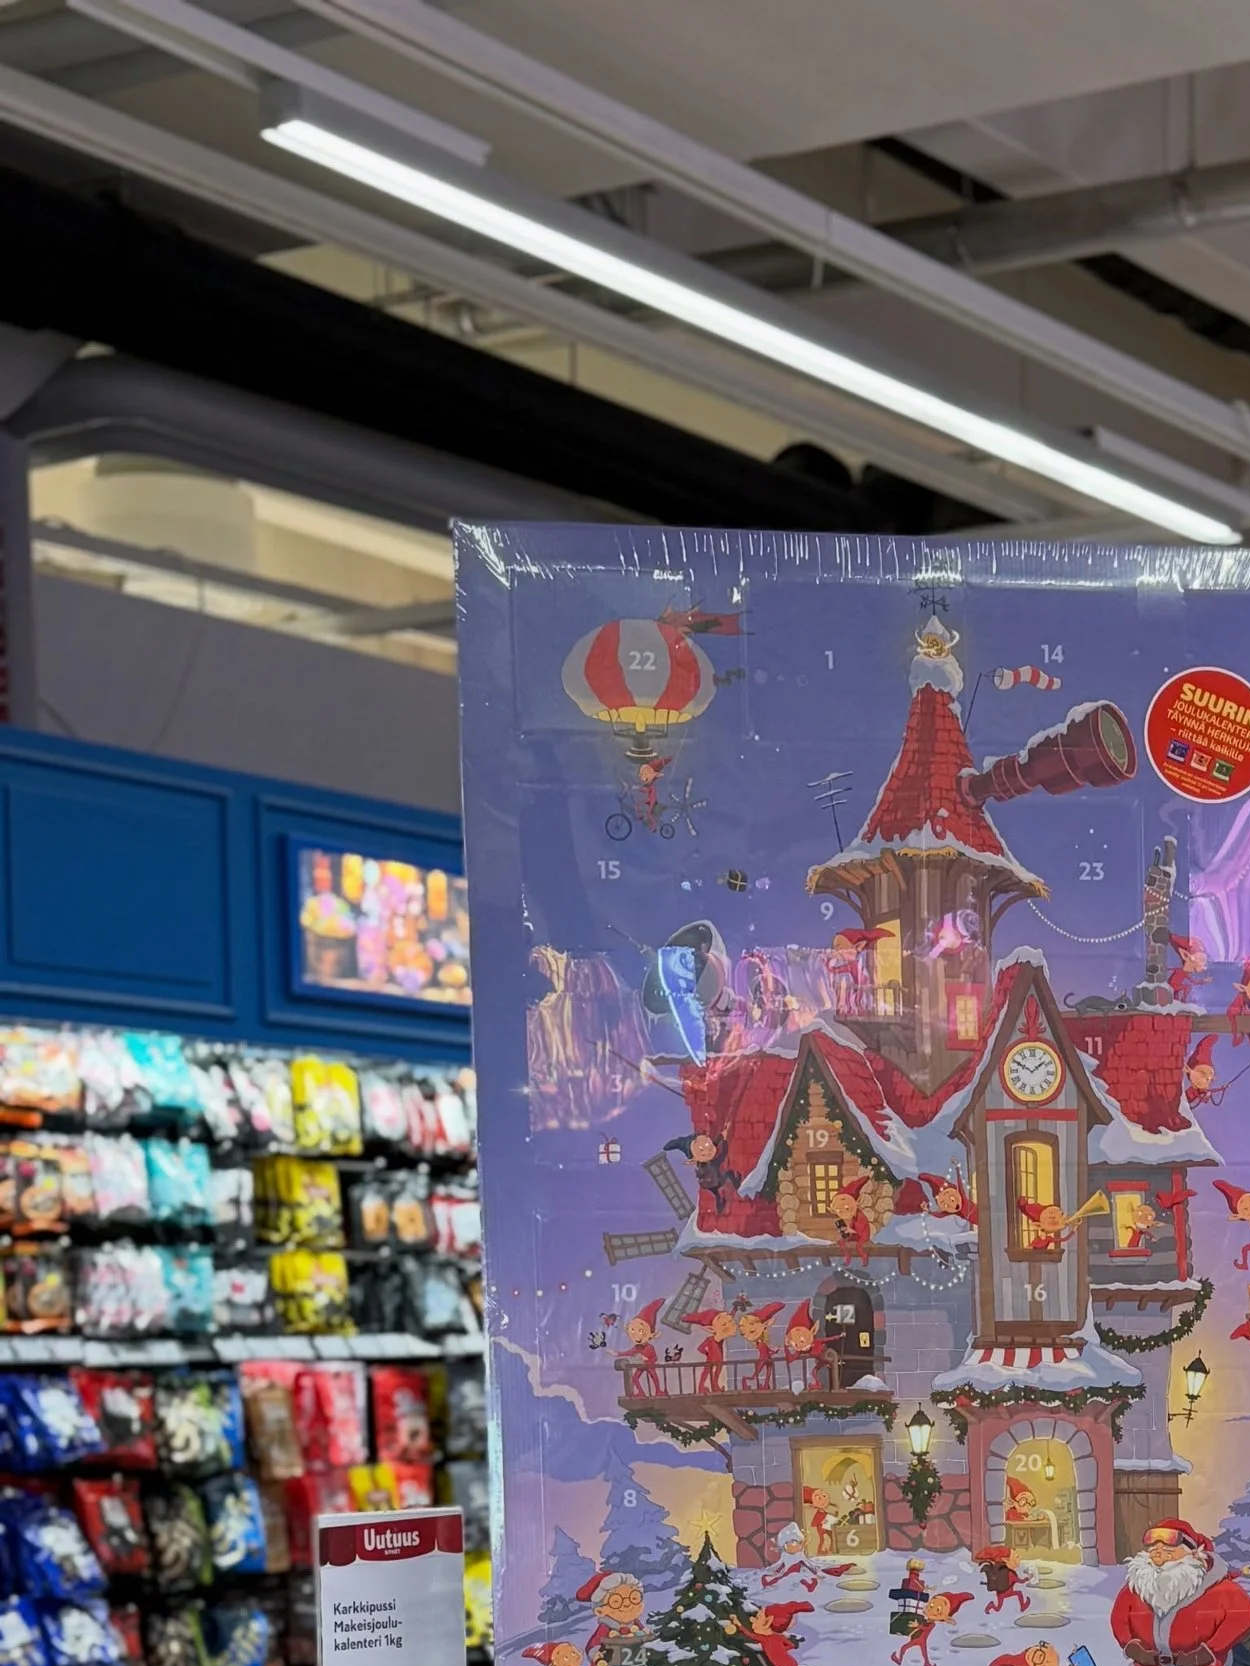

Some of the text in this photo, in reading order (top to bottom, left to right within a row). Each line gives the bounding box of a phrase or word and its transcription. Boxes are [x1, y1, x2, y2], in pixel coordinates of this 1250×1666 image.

[629, 652, 656, 670] 22
[825, 651, 834, 669] 1
[1041, 645, 1065, 663] 14
[1167, 709, 1205, 732] TÄYNNÄ
[1178, 729, 1208, 747] riittää
[1210, 741, 1244, 762] kaikille
[598, 861, 621, 879] 15
[1079, 862, 1104, 880] 23
[820, 903, 834, 921] 9
[1084, 1037, 1103, 1055] 11
[611, 1074, 622, 1092] 3
[805, 1130, 829, 1148] 19
[611, 1284, 637, 1302] 10
[1023, 1284, 1047, 1302] 16
[831, 1305, 855, 1323] 12
[1015, 1454, 1042, 1472] 20
[623, 1489, 637, 1507] 8
[363, 1528, 420, 1551] Uutuus
[846, 1529, 859, 1547] 6
[333, 1599, 397, 1616] Karkkipussi
[334, 1618, 402, 1633] Makeisjoulu-
[334, 1634, 402, 1651] kalenteri 1kg
[620, 1648, 647, 1666] 24
